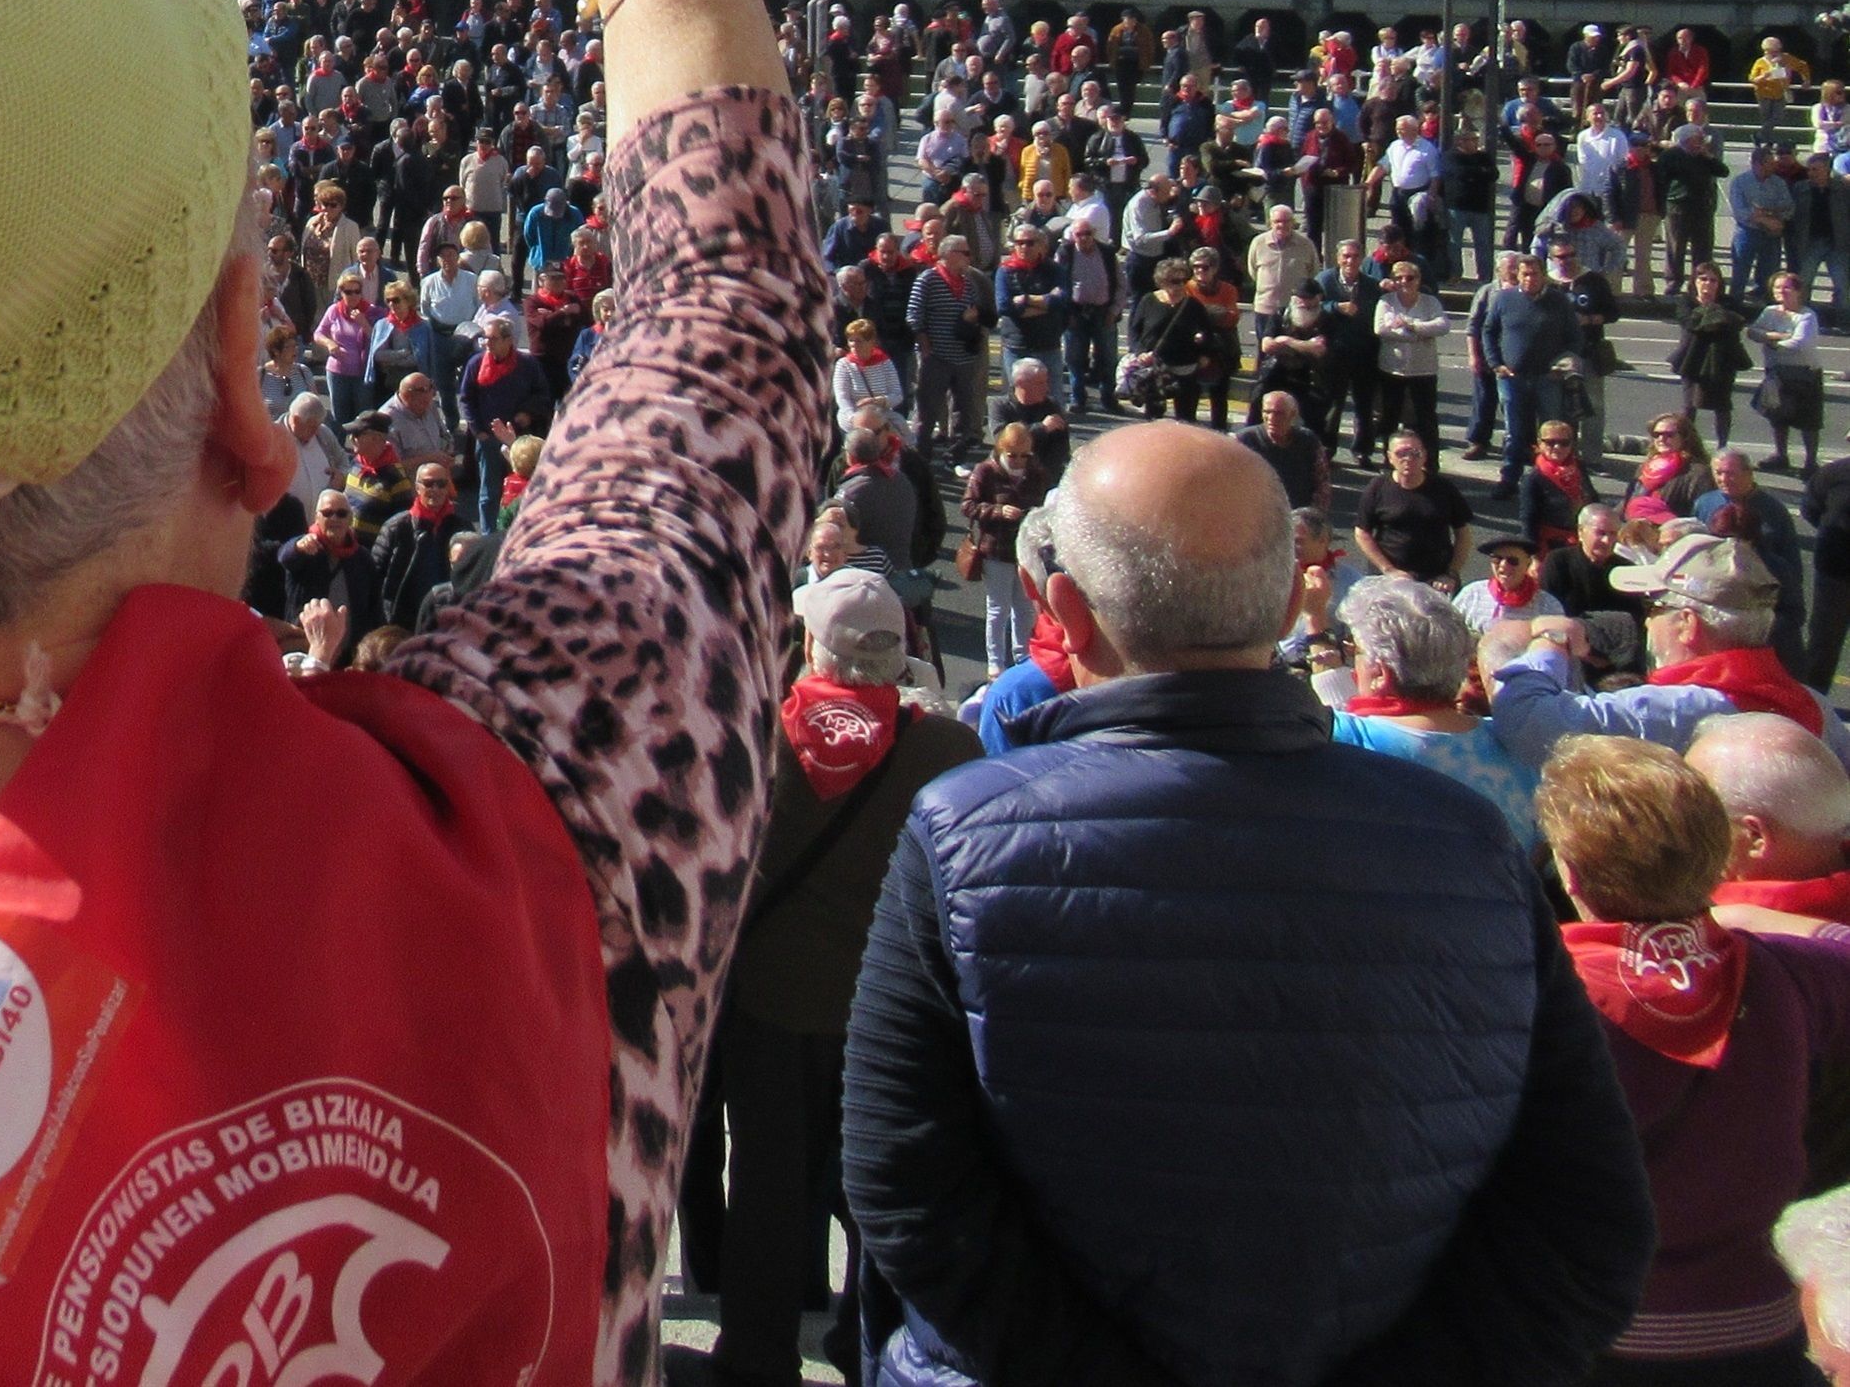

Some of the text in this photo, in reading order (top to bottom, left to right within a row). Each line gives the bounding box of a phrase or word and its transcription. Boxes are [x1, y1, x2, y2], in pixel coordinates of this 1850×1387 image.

[825, 714, 860, 733] MPB
[214, 1132, 441, 1213] MOBIMENDUA
[53, 1094, 403, 1365] PENSIONISTAS DE BIZKAIA
